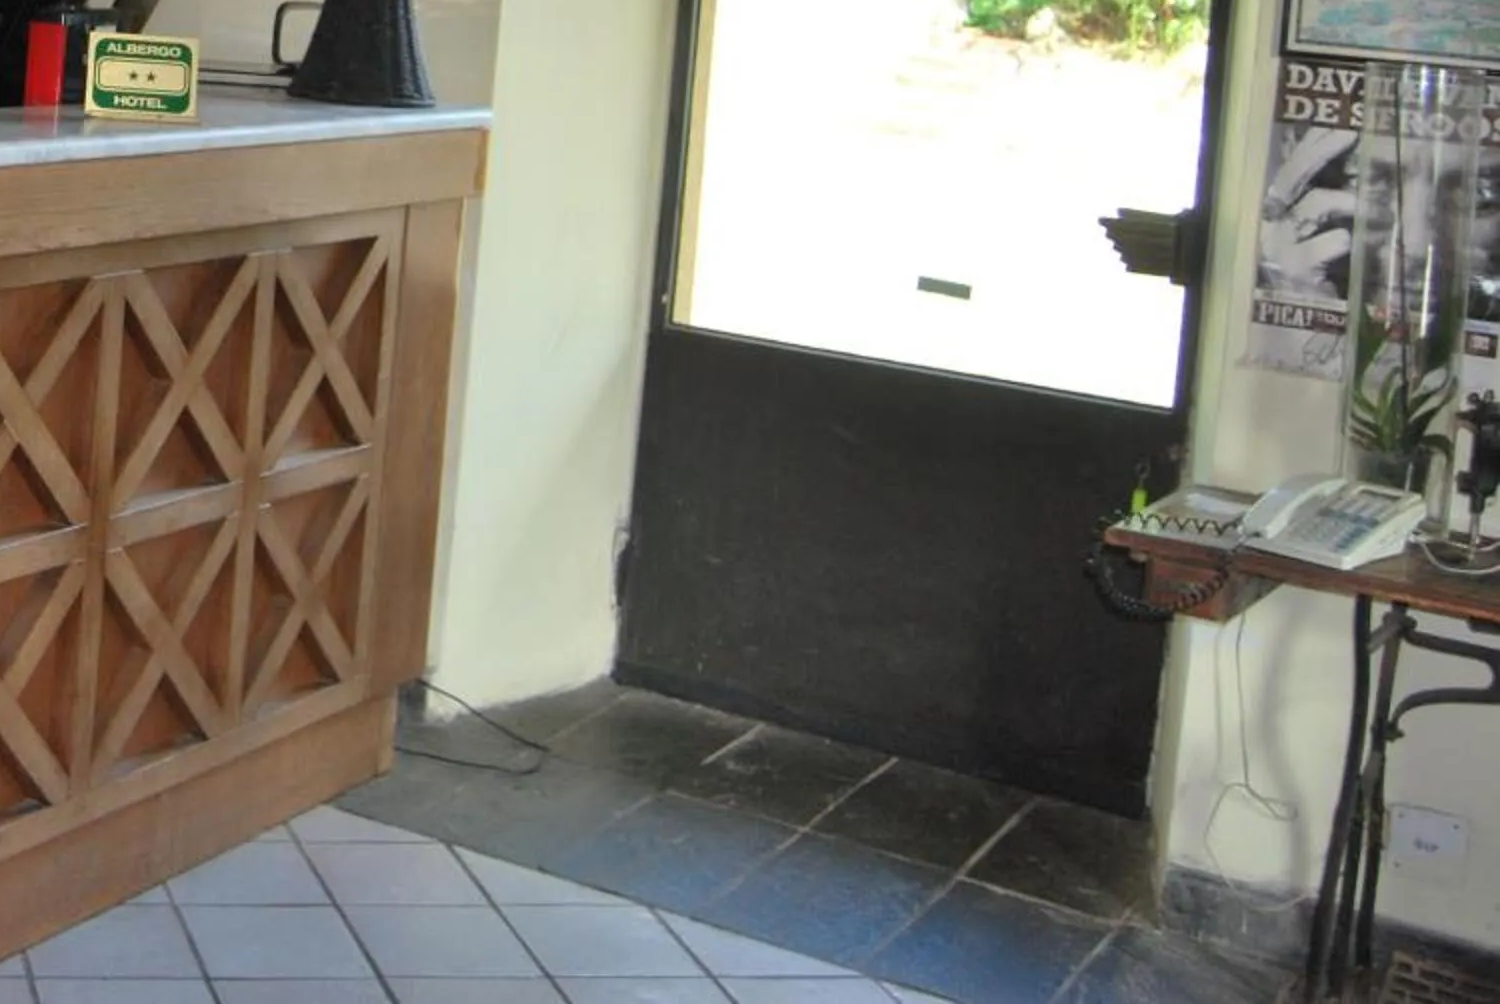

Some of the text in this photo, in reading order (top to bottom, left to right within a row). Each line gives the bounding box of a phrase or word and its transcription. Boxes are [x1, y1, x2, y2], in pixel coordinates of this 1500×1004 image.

[106, 41, 182, 58] ALBERGO
[112, 95, 168, 110] HOTEL
[1283, 94, 1341, 123] DE
